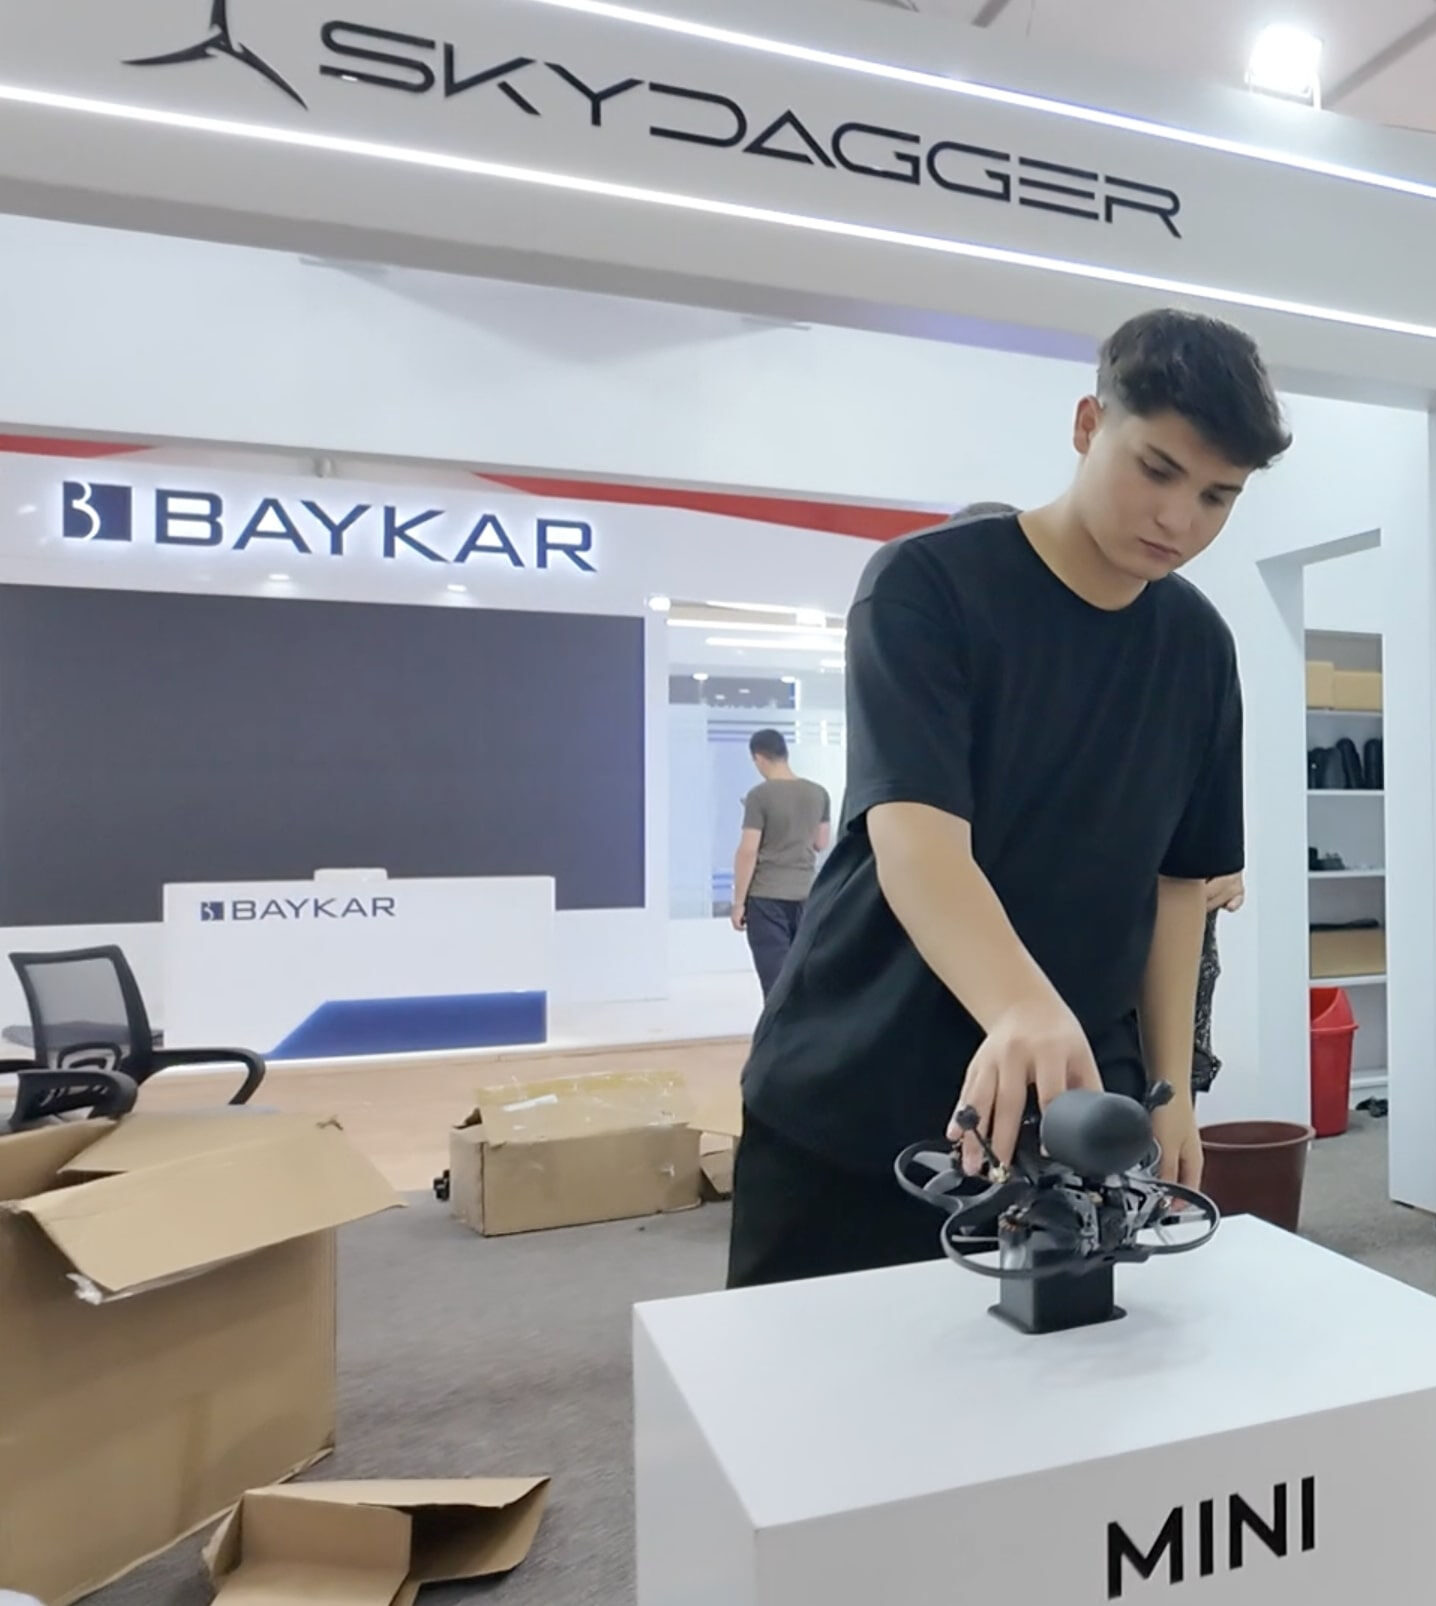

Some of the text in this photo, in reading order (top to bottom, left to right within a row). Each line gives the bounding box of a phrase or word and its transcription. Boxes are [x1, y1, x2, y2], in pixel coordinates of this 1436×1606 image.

[320, 20, 1181, 238] SKYDAGGER
[155, 488, 596, 572] BAYKAR
[232, 897, 395, 921] BAYKAR
[1107, 1475, 1315, 1599] MINI
